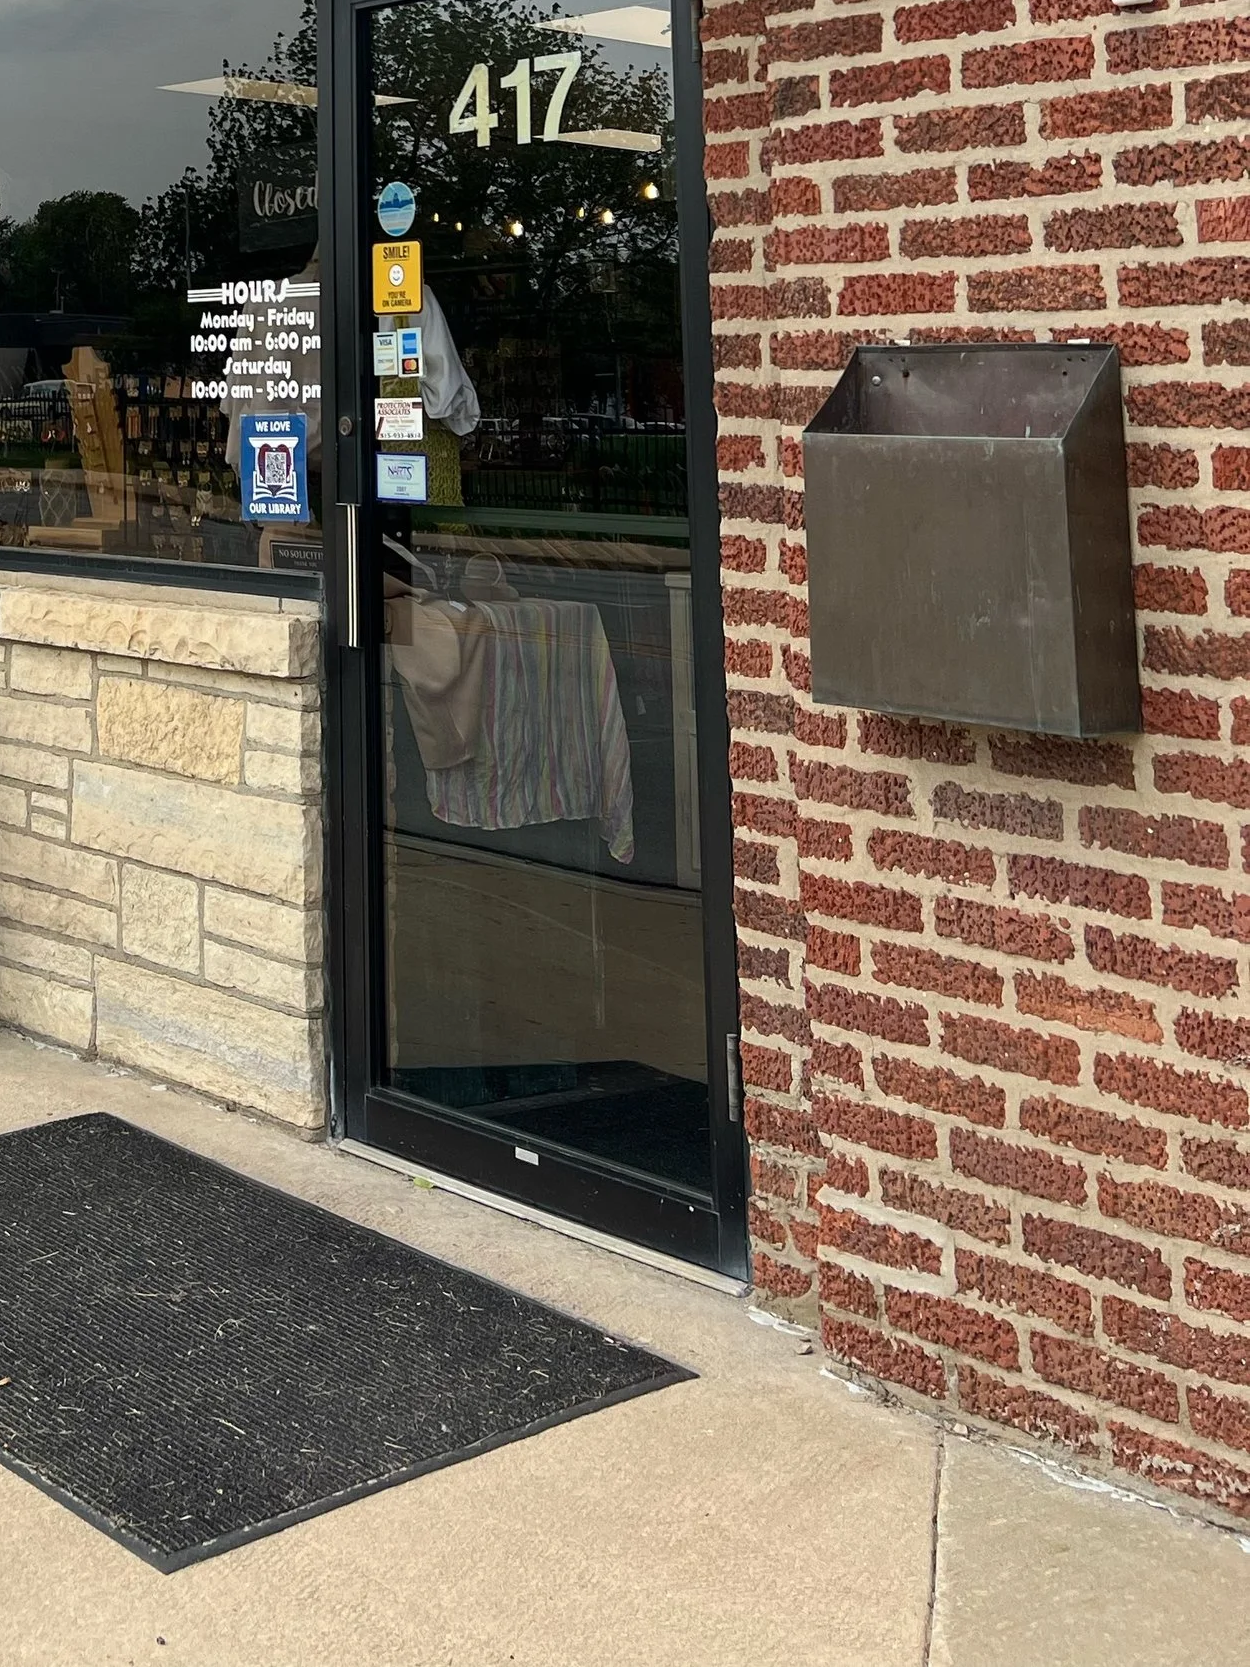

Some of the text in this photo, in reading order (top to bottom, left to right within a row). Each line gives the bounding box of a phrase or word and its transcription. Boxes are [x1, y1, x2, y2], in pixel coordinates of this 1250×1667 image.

[449, 51, 582, 149] 417
[253, 170, 319, 217] Closed
[383, 245, 410, 260] SMILE!
[221, 278, 291, 305] HOURS
[387, 291, 406, 300] YOU'RE
[382, 298, 412, 308] ON CAMERA
[200, 310, 255, 333] Monday
[267, 307, 315, 330] Friday
[190, 334, 228, 352] 10:00
[230, 337, 253, 352] am
[265, 331, 300, 351] 6:00
[222, 356, 292, 380] Saturday
[191, 381, 228, 399] 10:00
[230, 384, 254, 399] am
[266, 380, 300, 402] 5:00
[255, 420, 291, 432] WE LOVE
[249, 503, 302, 515] OUR LIBRARY
[278, 549, 290, 558] NO
